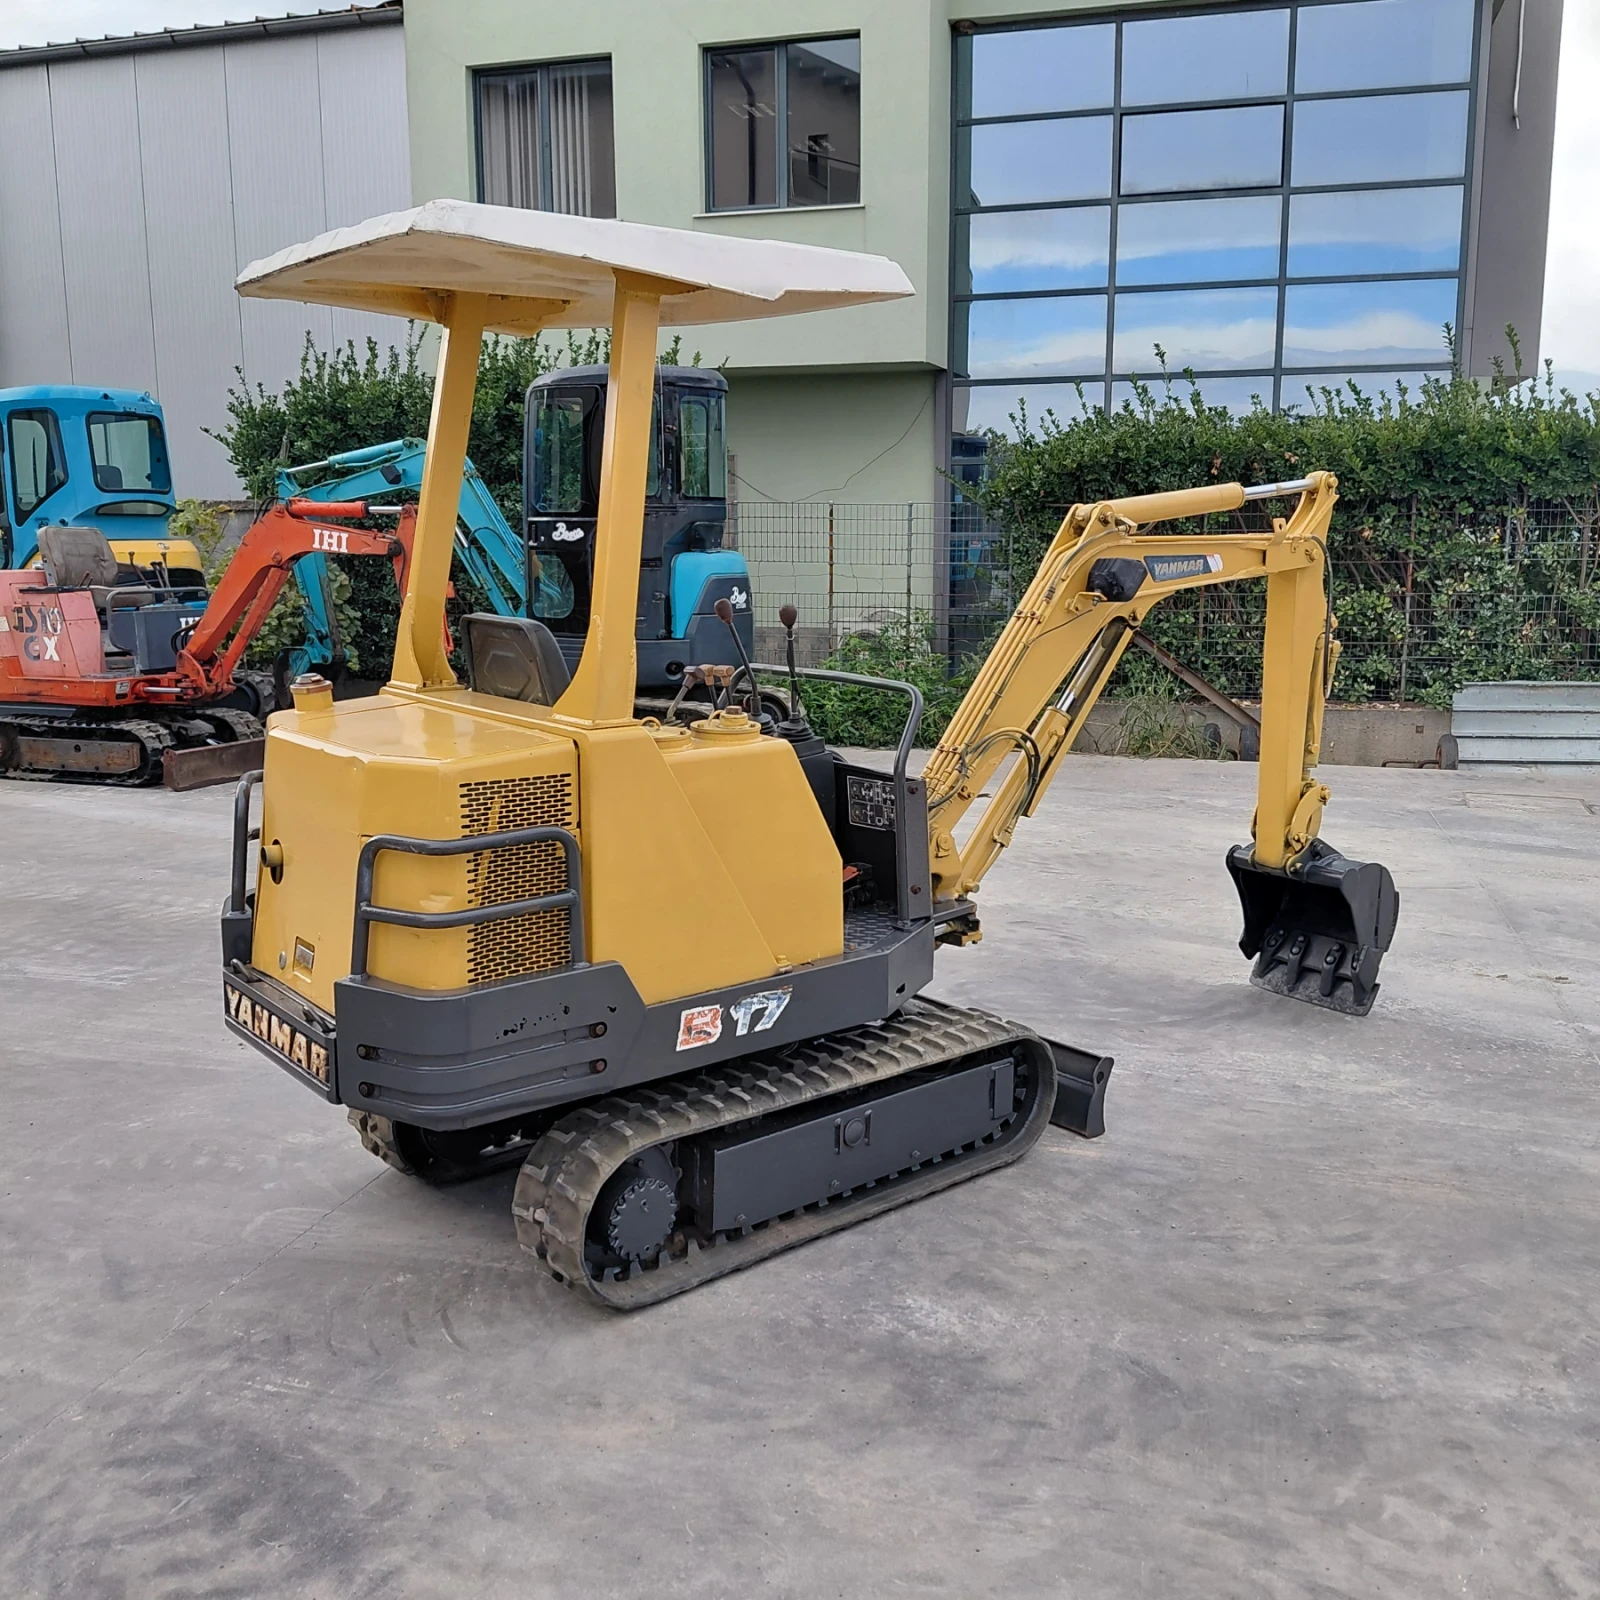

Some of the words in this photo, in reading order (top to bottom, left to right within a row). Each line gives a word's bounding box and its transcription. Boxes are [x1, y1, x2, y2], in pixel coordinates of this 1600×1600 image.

[312, 528, 349, 553] IHI
[1153, 559, 1205, 576] YANMAR
[225, 983, 329, 1081] YANMAR
